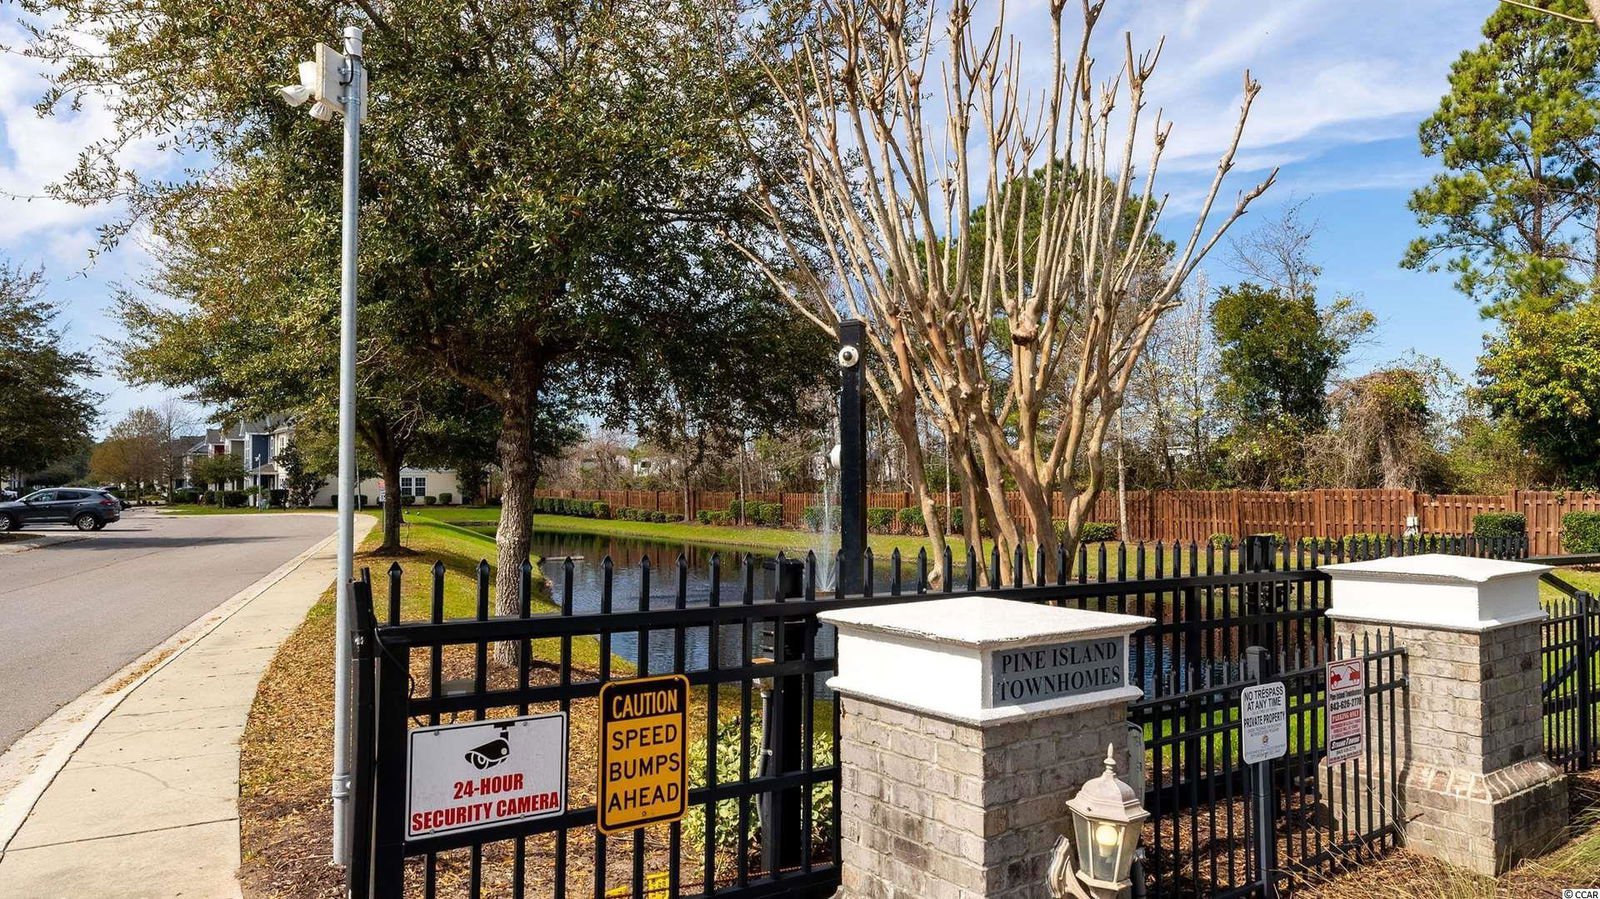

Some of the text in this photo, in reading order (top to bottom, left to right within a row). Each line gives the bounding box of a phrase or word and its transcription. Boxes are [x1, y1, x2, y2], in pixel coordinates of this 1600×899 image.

[1002, 642, 1117, 674] PINE ISLAND
[997, 665, 1120, 701] TOWNHOMES
[1244, 686, 1284, 702] NO TRESPASS
[612, 688, 678, 719] CAUTION
[1247, 701, 1254, 712] AT
[1255, 699, 1267, 710] ANY
[1268, 696, 1282, 707] TIME
[1243, 715, 1262, 728] PRIVATE
[1263, 711, 1285, 725] PROPERTY
[612, 724, 678, 751] SPEED
[609, 753, 681, 783] BUMPS
[453, 773, 524, 800] 24-HOUR
[607, 782, 680, 813] AHEAD
[412, 791, 559, 832] SECURITY CAMERA
